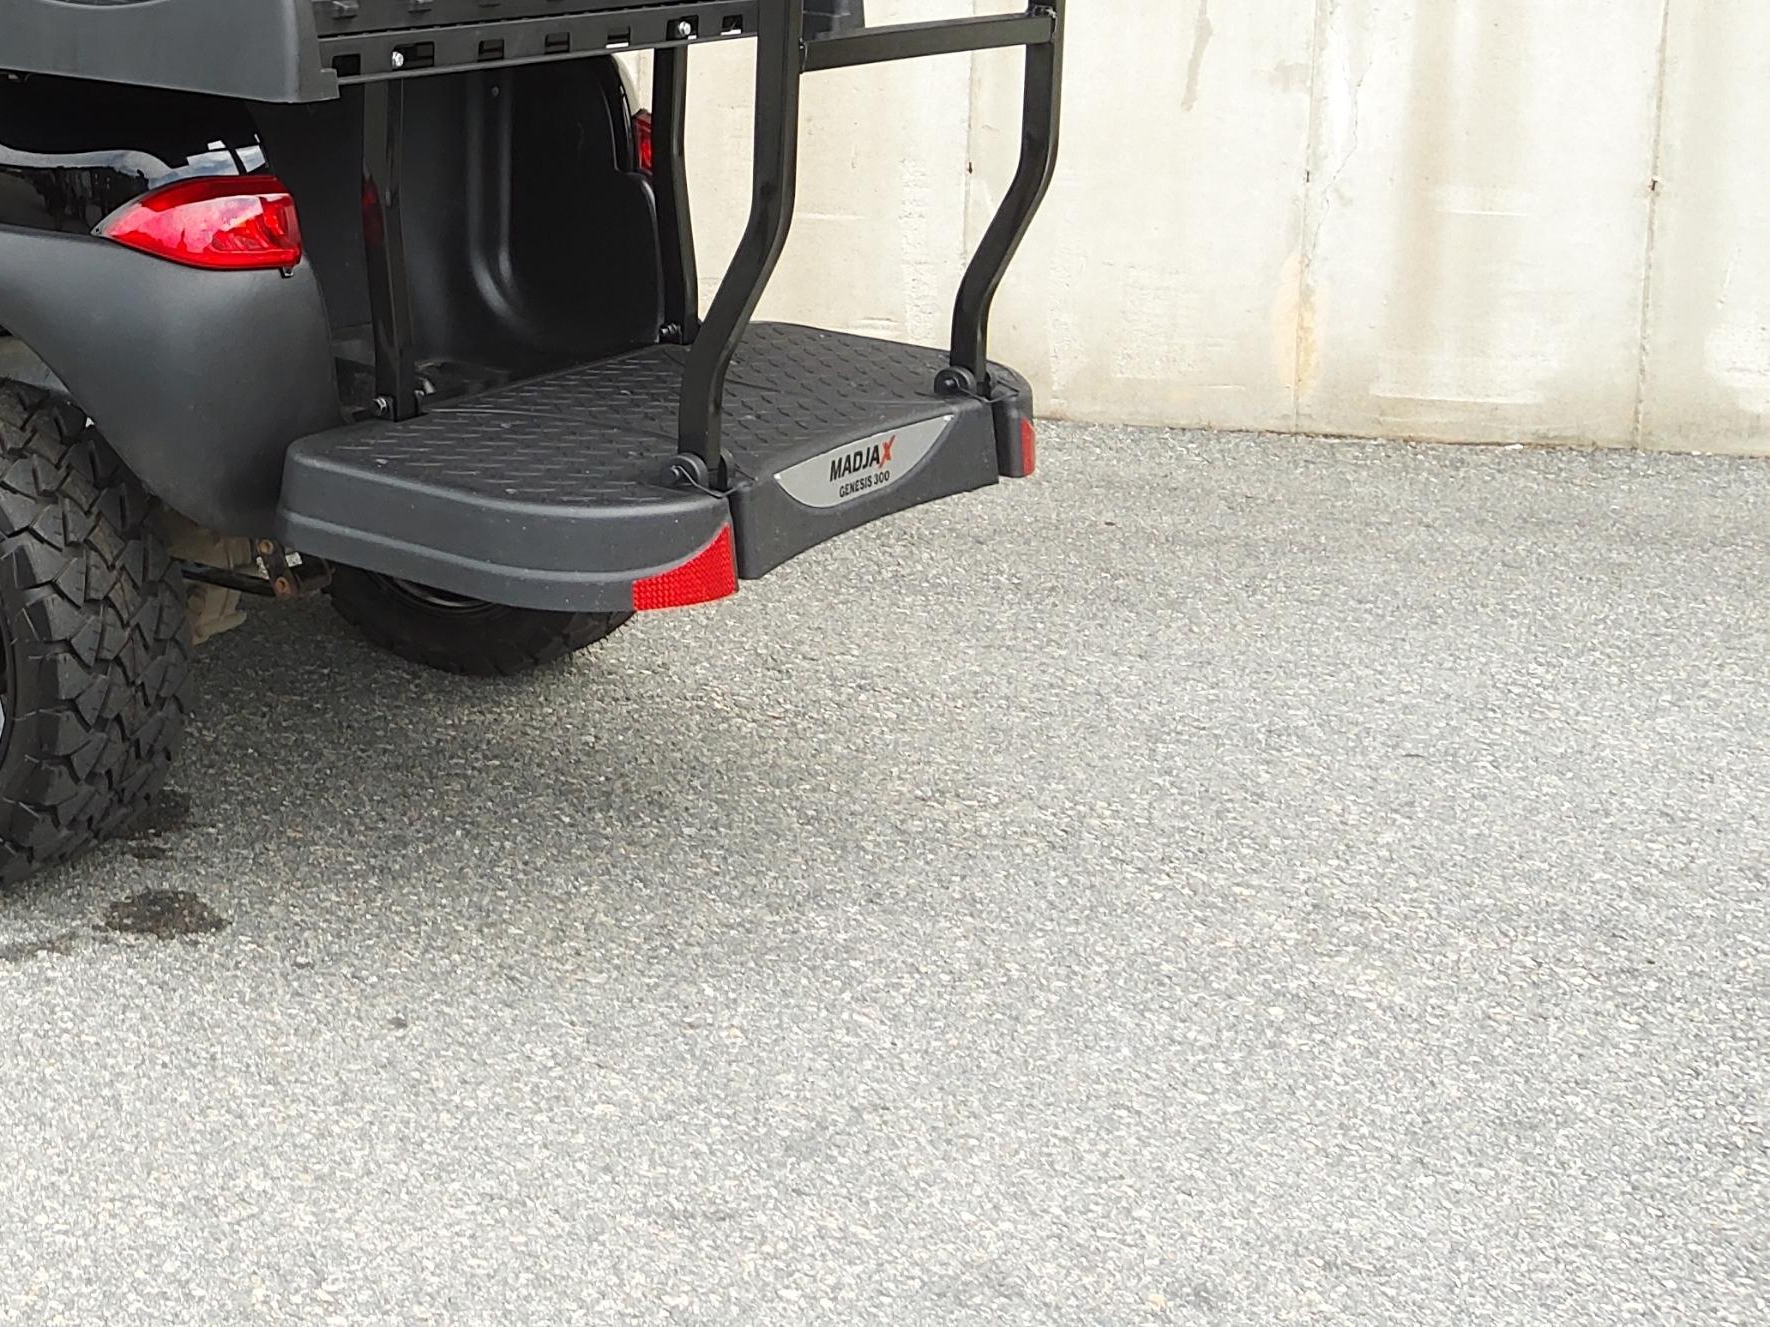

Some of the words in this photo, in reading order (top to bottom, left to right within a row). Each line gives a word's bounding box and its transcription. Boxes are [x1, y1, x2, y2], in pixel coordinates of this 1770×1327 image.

[830, 435, 896, 481] MADJAX
[839, 476, 872, 498] GENESIS
[874, 470, 890, 485] 300
